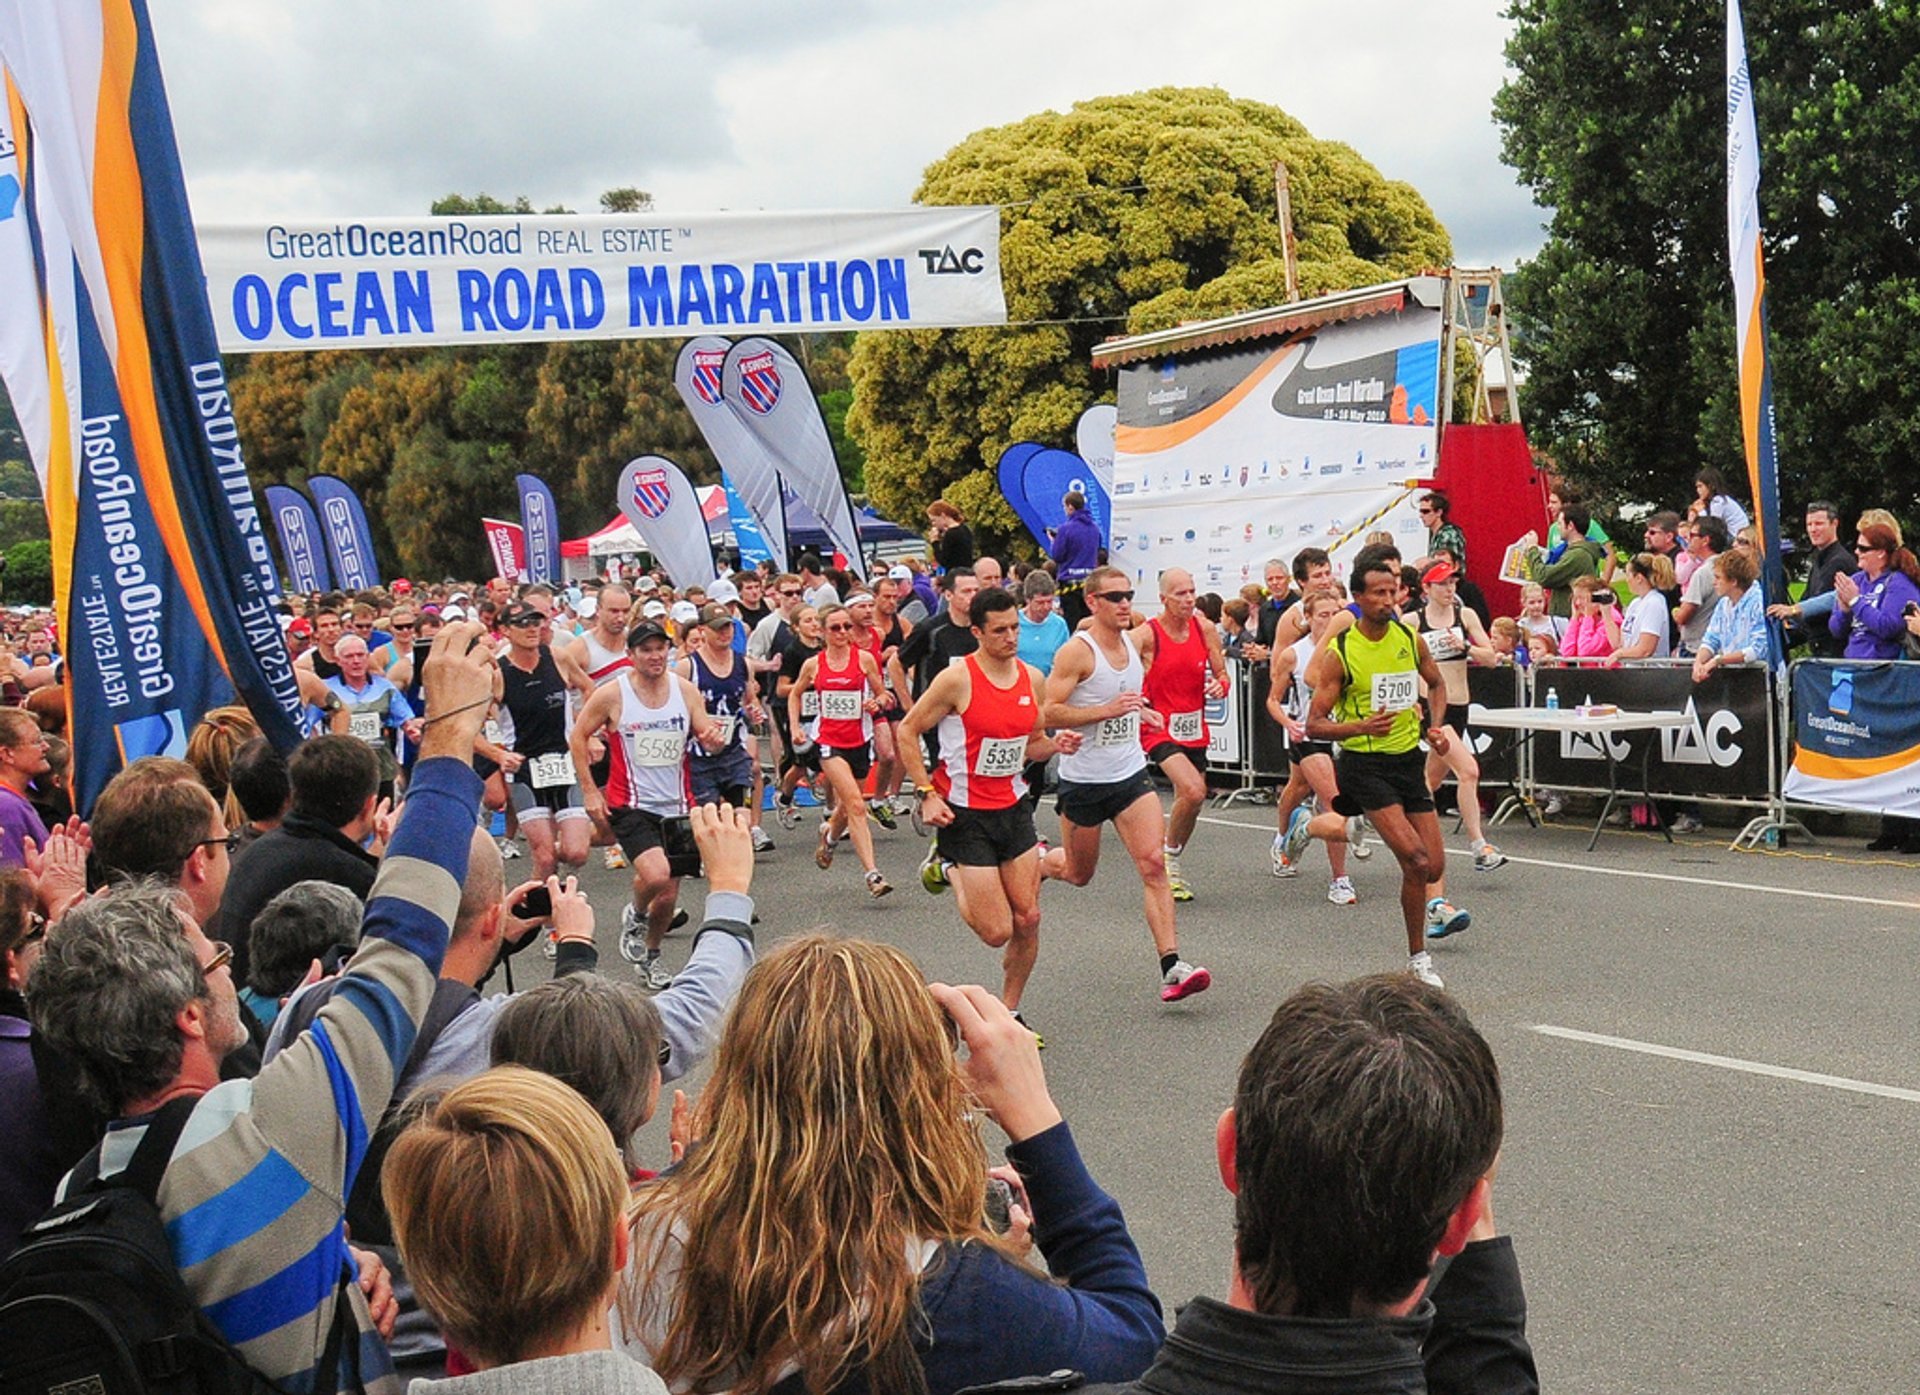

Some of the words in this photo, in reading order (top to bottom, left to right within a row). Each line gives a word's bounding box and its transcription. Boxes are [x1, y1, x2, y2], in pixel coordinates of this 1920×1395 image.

[266, 222, 522, 259] GreatOceanRoad
[538, 231, 593, 254] REAL
[603, 228, 673, 253] ESTATE
[919, 244, 984, 275] TAC
[233, 269, 435, 342] OCEAN
[458, 267, 606, 332] ROAD
[628, 258, 910, 327] MARATHON
[1378, 680, 1412, 700] 5700
[1103, 717, 1135, 735] 5381
